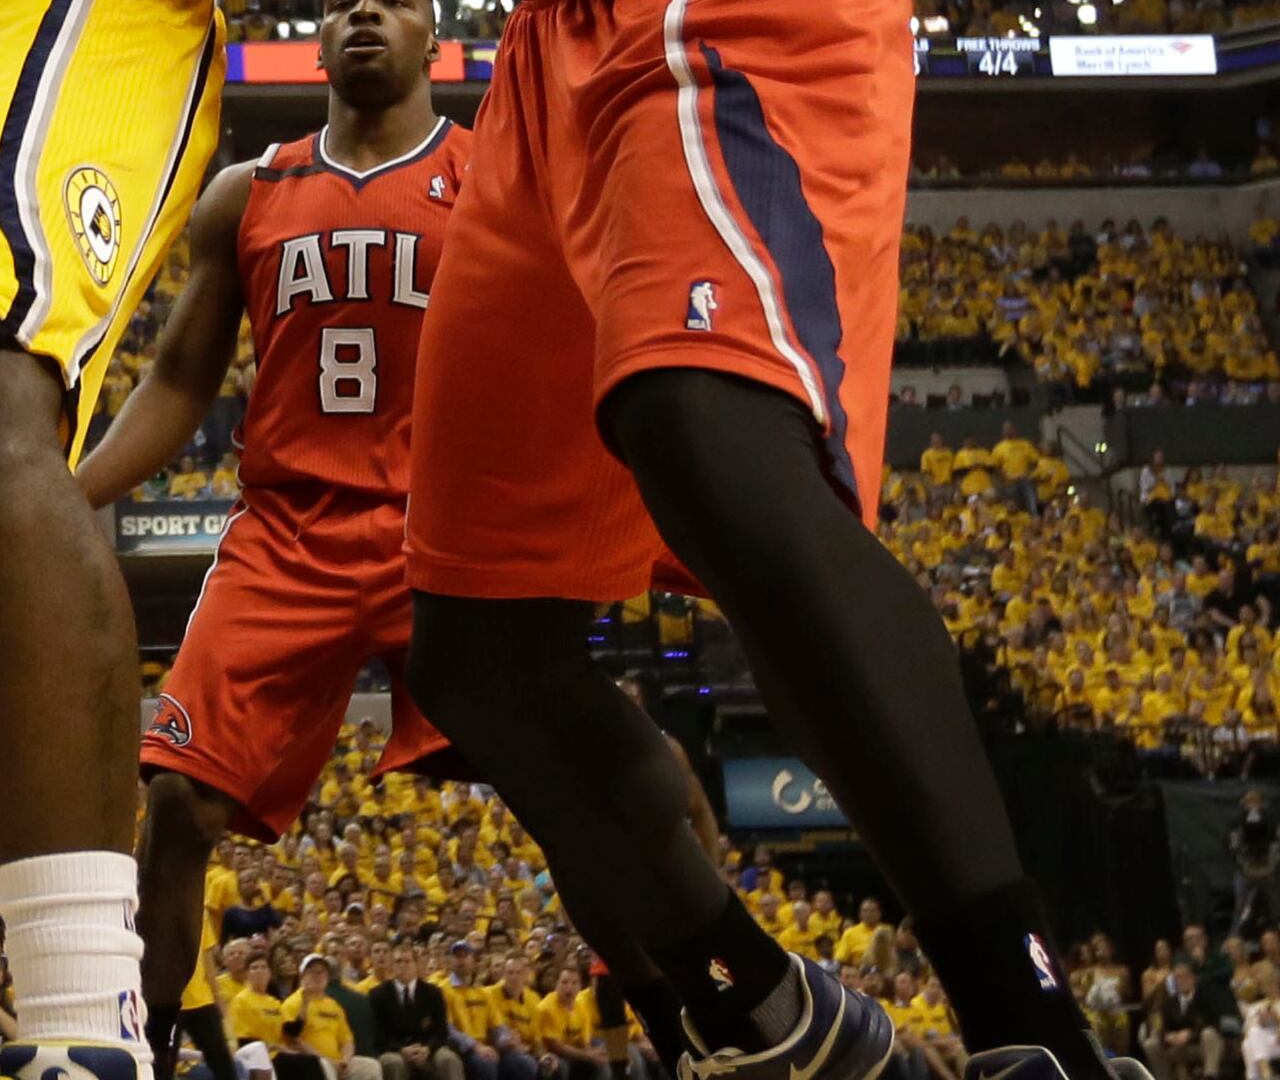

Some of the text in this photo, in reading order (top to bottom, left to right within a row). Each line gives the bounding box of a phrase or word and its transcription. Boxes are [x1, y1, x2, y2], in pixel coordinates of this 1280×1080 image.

[957, 37, 987, 51] FREE
[978, 51, 1017, 76] 4/4
[276, 229, 430, 316] ATL
[320, 328, 376, 413] 8
[121, 514, 201, 536] SPORT
